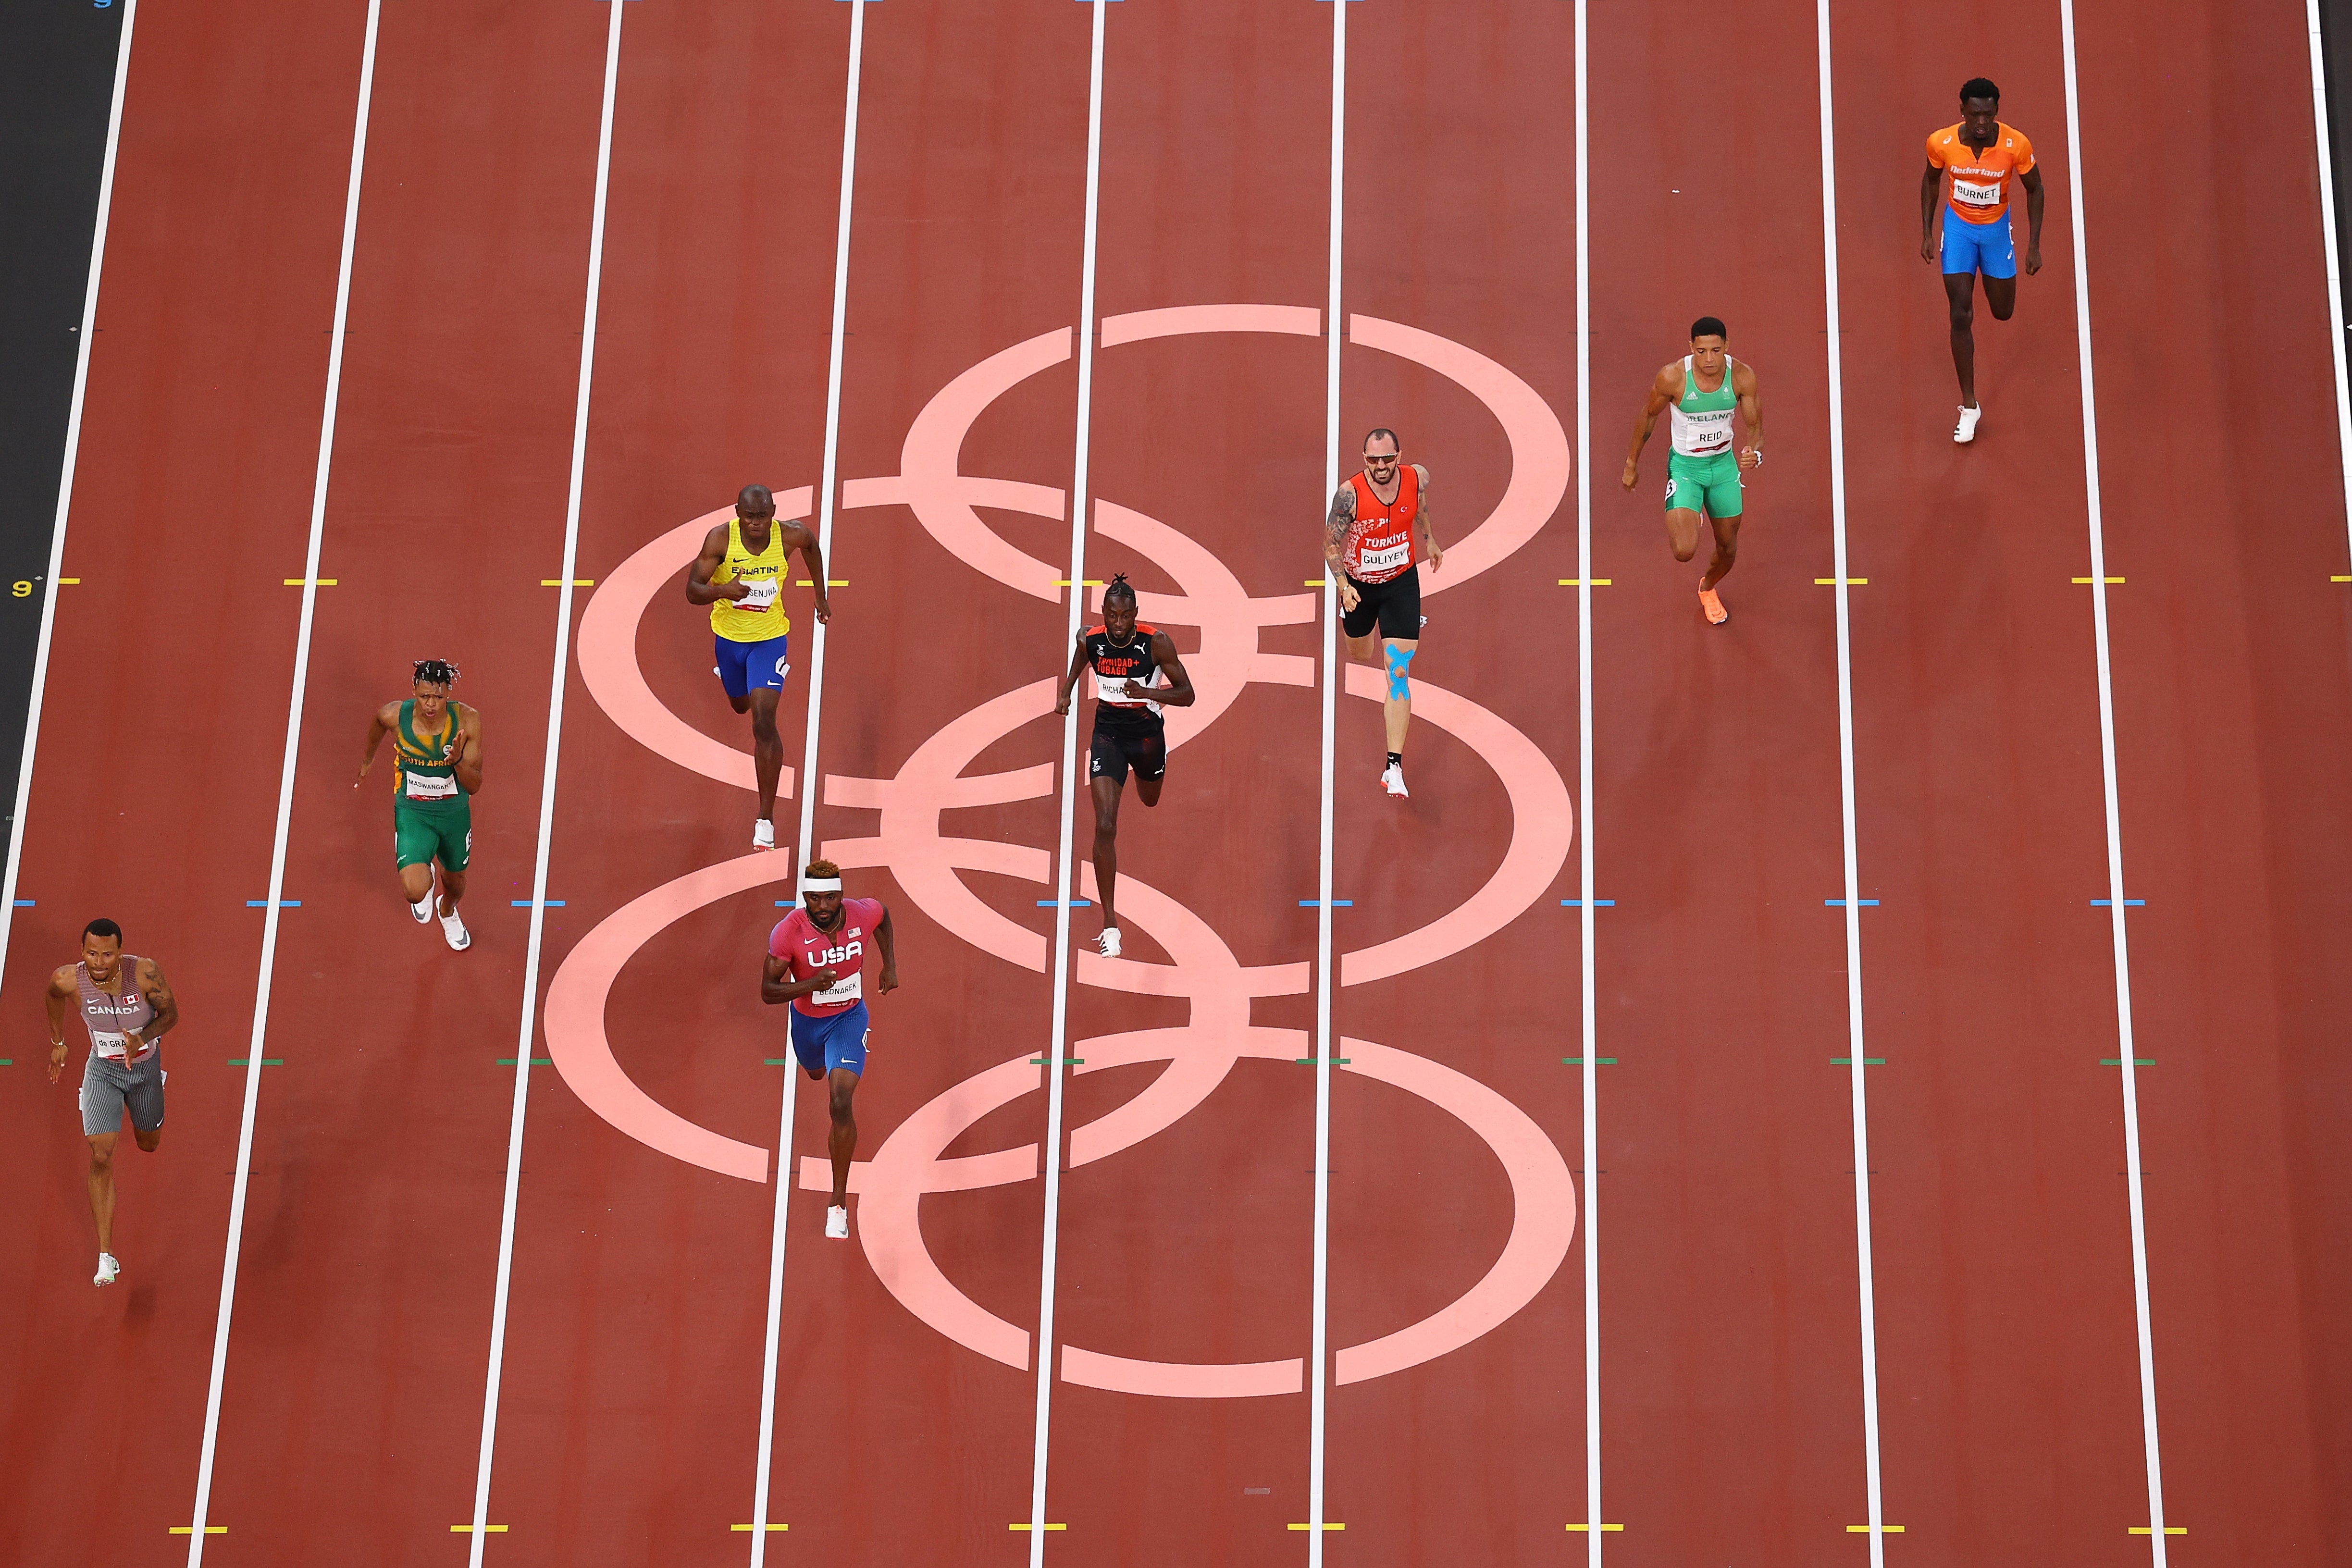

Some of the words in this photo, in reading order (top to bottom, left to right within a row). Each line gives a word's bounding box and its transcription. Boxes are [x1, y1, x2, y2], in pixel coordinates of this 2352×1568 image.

[1957, 185, 1996, 199] BURNET
[1699, 431, 1722, 442] REID
[1666, 482, 1672, 496] 3
[1365, 531, 1407, 548] TÜRKİYE
[1363, 549, 1406, 564] GULIYEV
[12, 580, 32, 597] 9
[748, 586, 777, 597] SENJWA
[1097, 664, 1127, 676] TOBAGO
[1102, 684, 1125, 694] RICHA
[408, 779, 453, 790] MASWANGANYI
[807, 940, 862, 967] USA
[819, 981, 857, 996] BEDNAREK
[87, 1005, 140, 1015] CANADA
